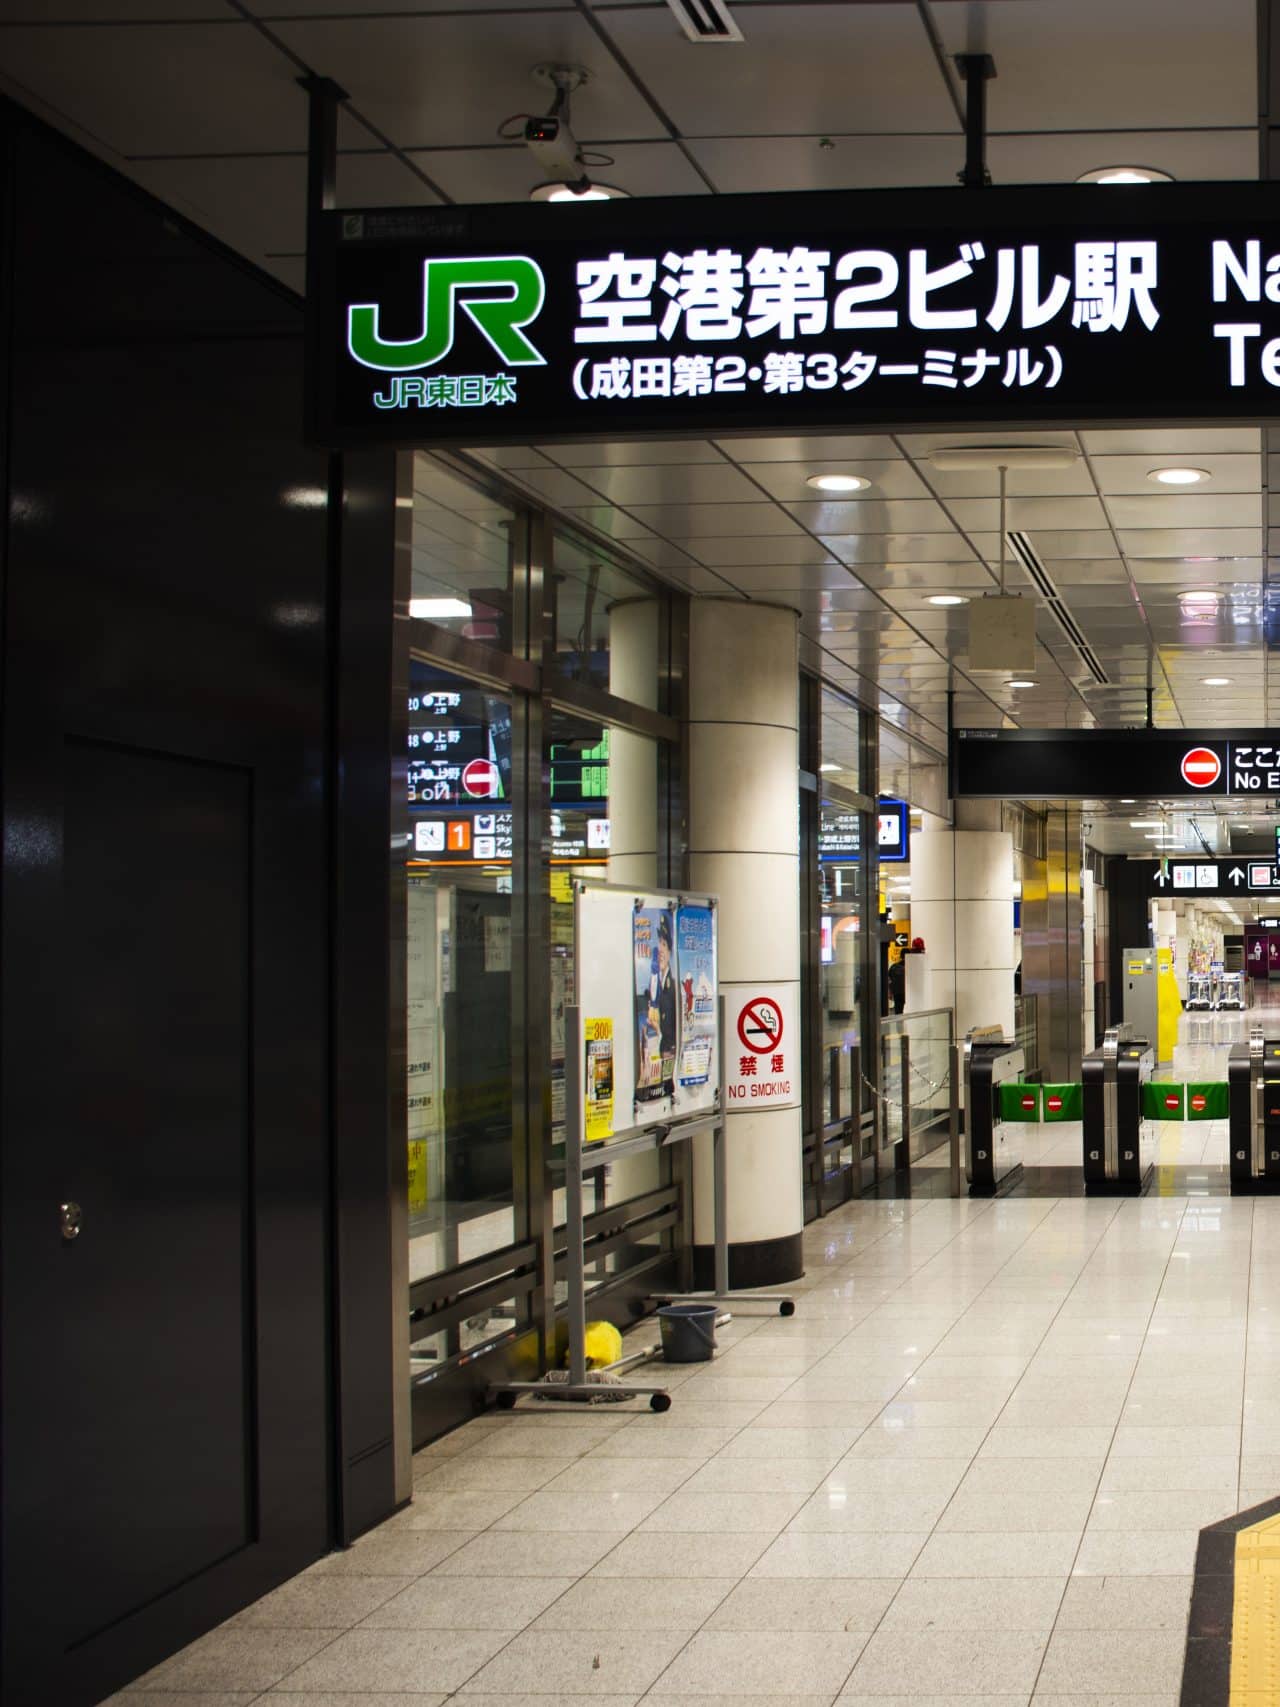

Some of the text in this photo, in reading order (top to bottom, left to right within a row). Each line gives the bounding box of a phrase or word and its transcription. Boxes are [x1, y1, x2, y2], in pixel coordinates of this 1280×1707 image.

[573, 240, 1160, 342] 空港第2ビル駅
[347, 253, 546, 371] JR
[373, 374, 517, 409] JR東日本
[1234, 772, 1261, 789] No
[453, 825, 463, 847] 1
[739, 1053, 784, 1077] 禁煙
[728, 1080, 791, 1099] NO SMOKING
